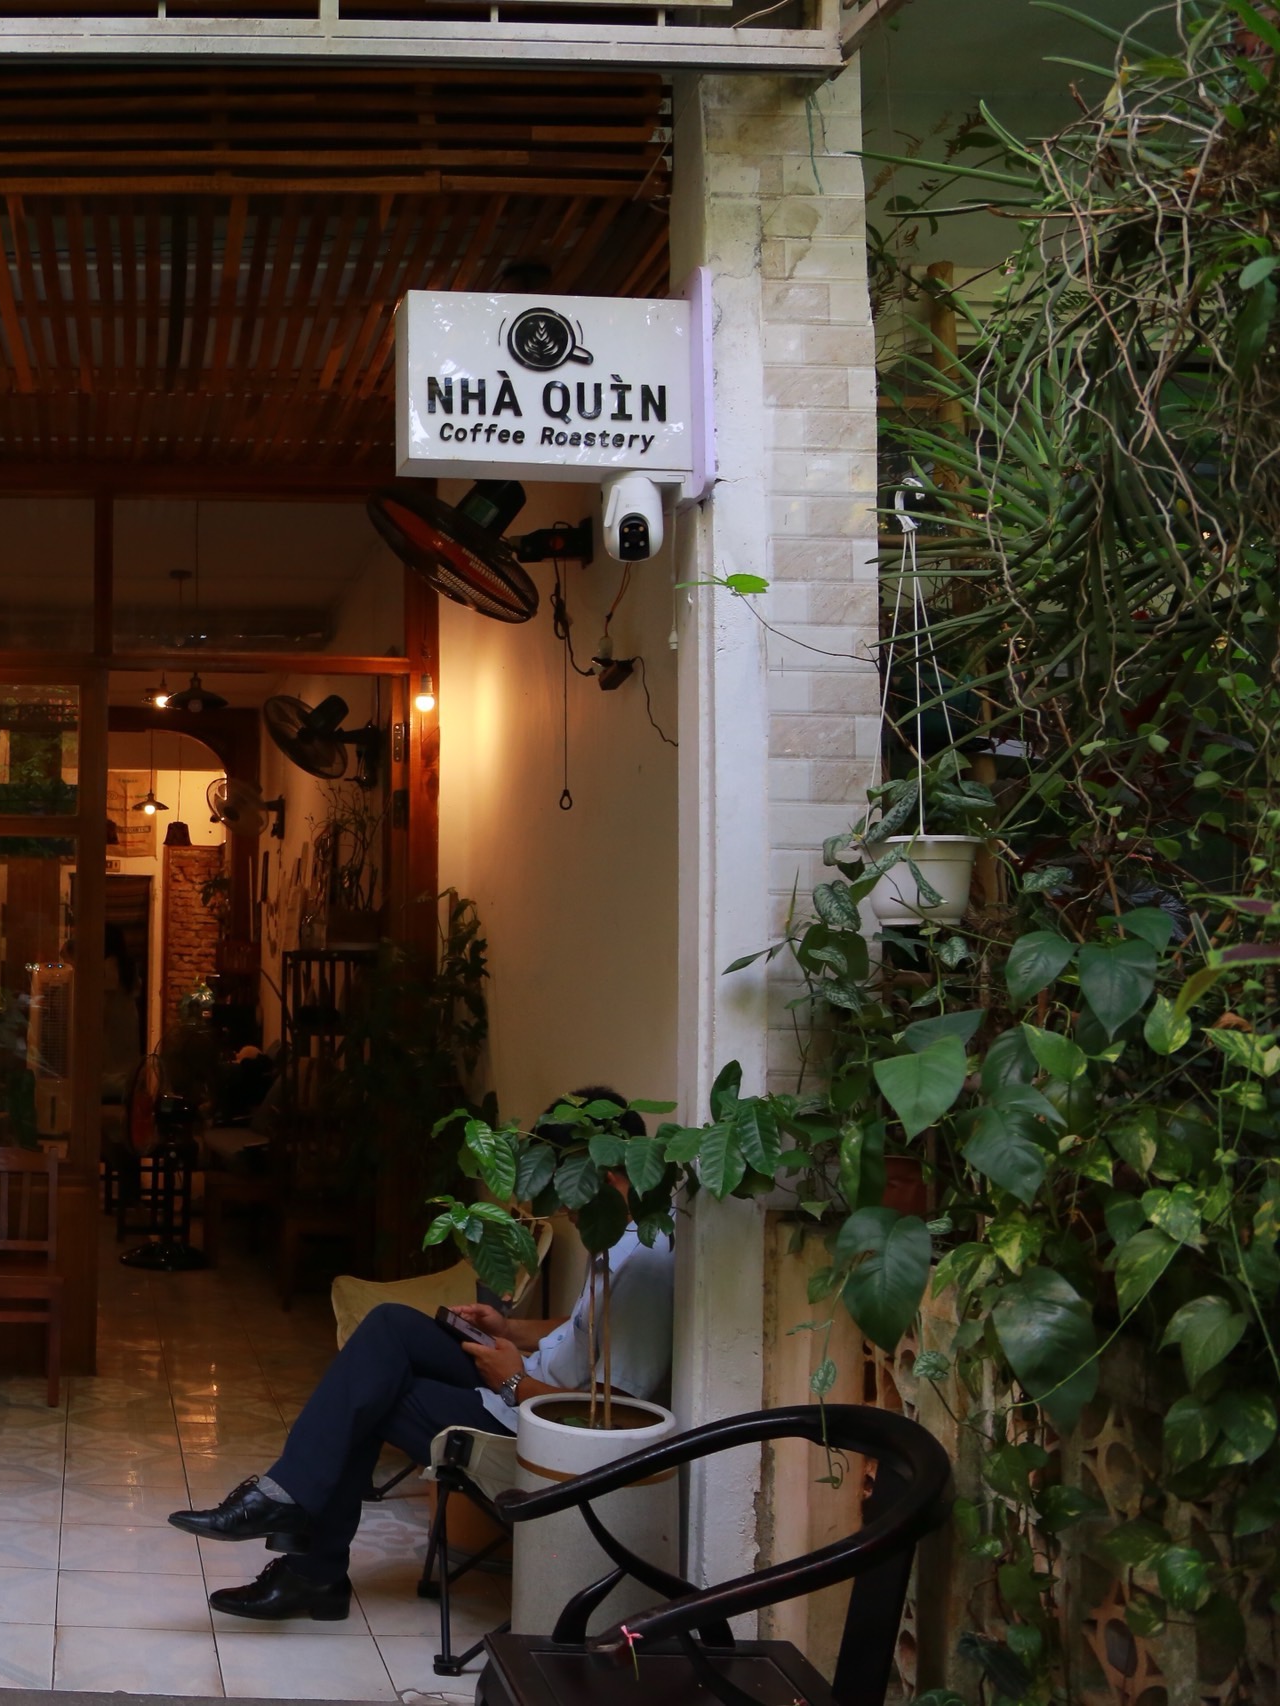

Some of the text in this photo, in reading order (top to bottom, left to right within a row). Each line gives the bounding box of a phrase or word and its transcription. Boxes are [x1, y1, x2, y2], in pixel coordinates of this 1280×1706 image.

[427, 370, 667, 424] NHÀ QUÌN
[439, 422, 656, 454] Coffee Roastery
